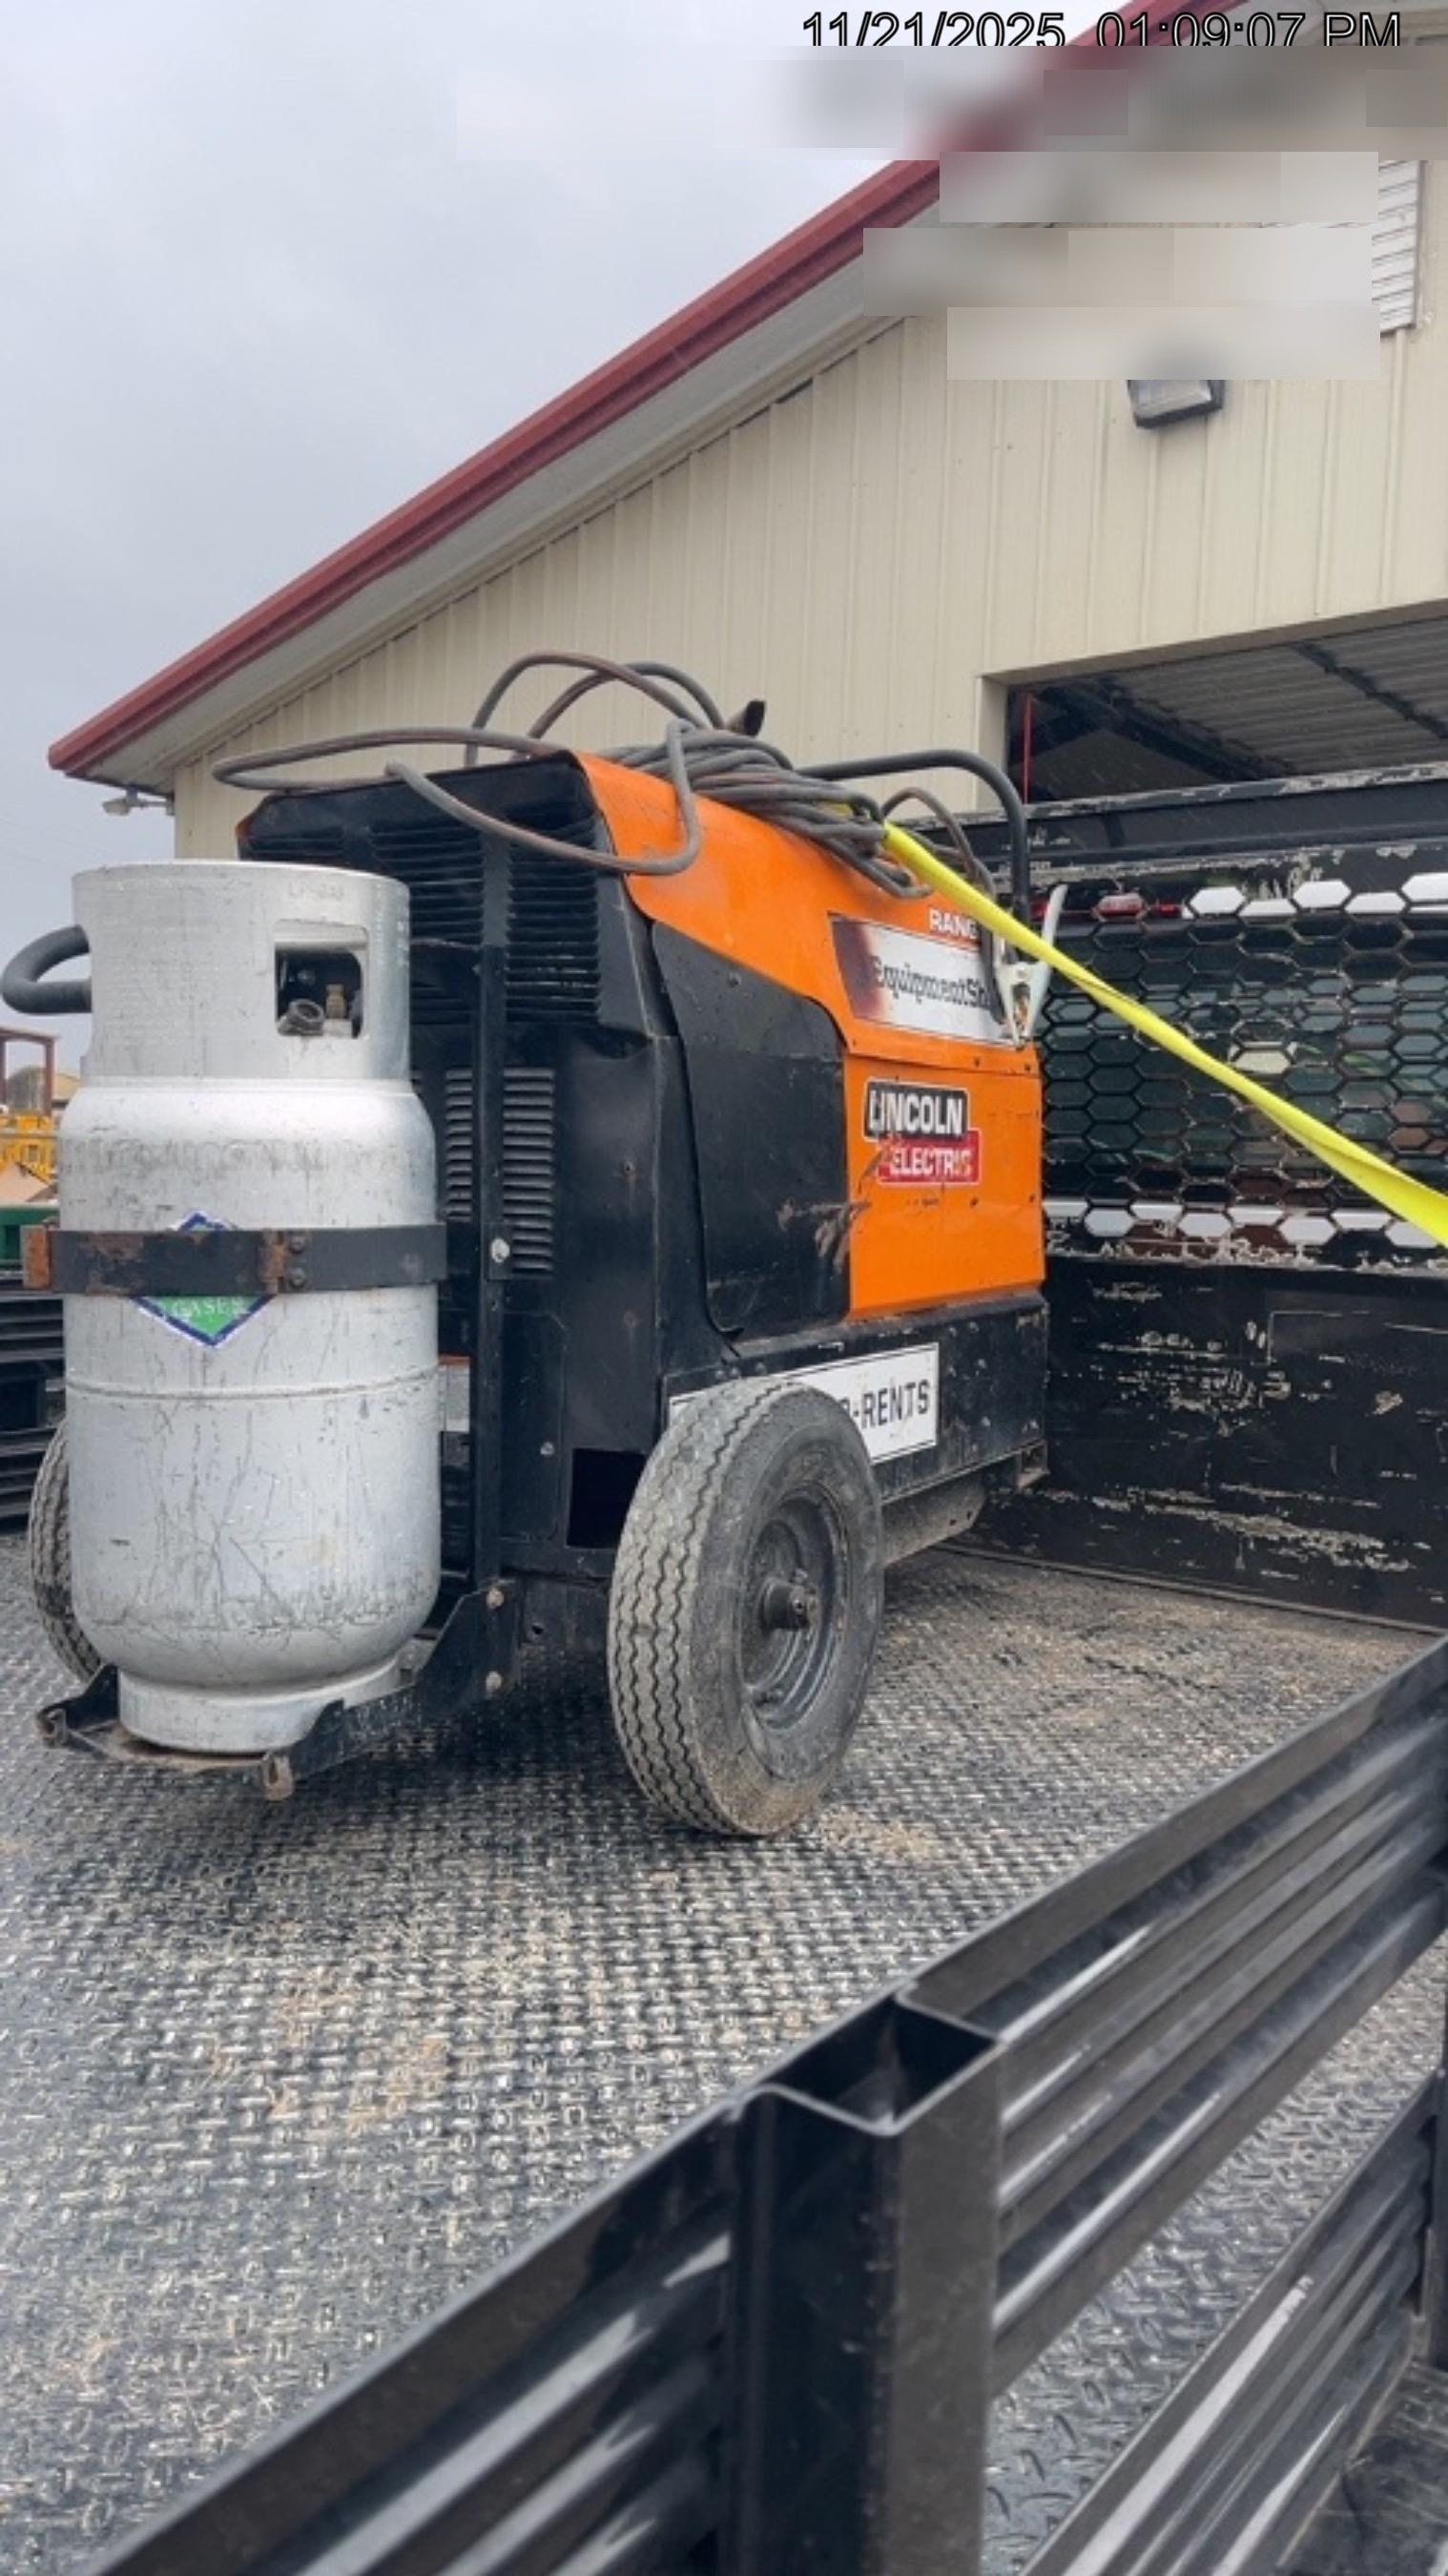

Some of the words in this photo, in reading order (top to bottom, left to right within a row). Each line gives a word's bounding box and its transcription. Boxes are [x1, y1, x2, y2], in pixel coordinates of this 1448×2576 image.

[929, 907, 979, 940] RANG
[869, 955, 991, 1008] EquipmentSh
[869, 1090, 963, 1136] LINCOLN
[889, 1146, 972, 1177] ELECTRIC
